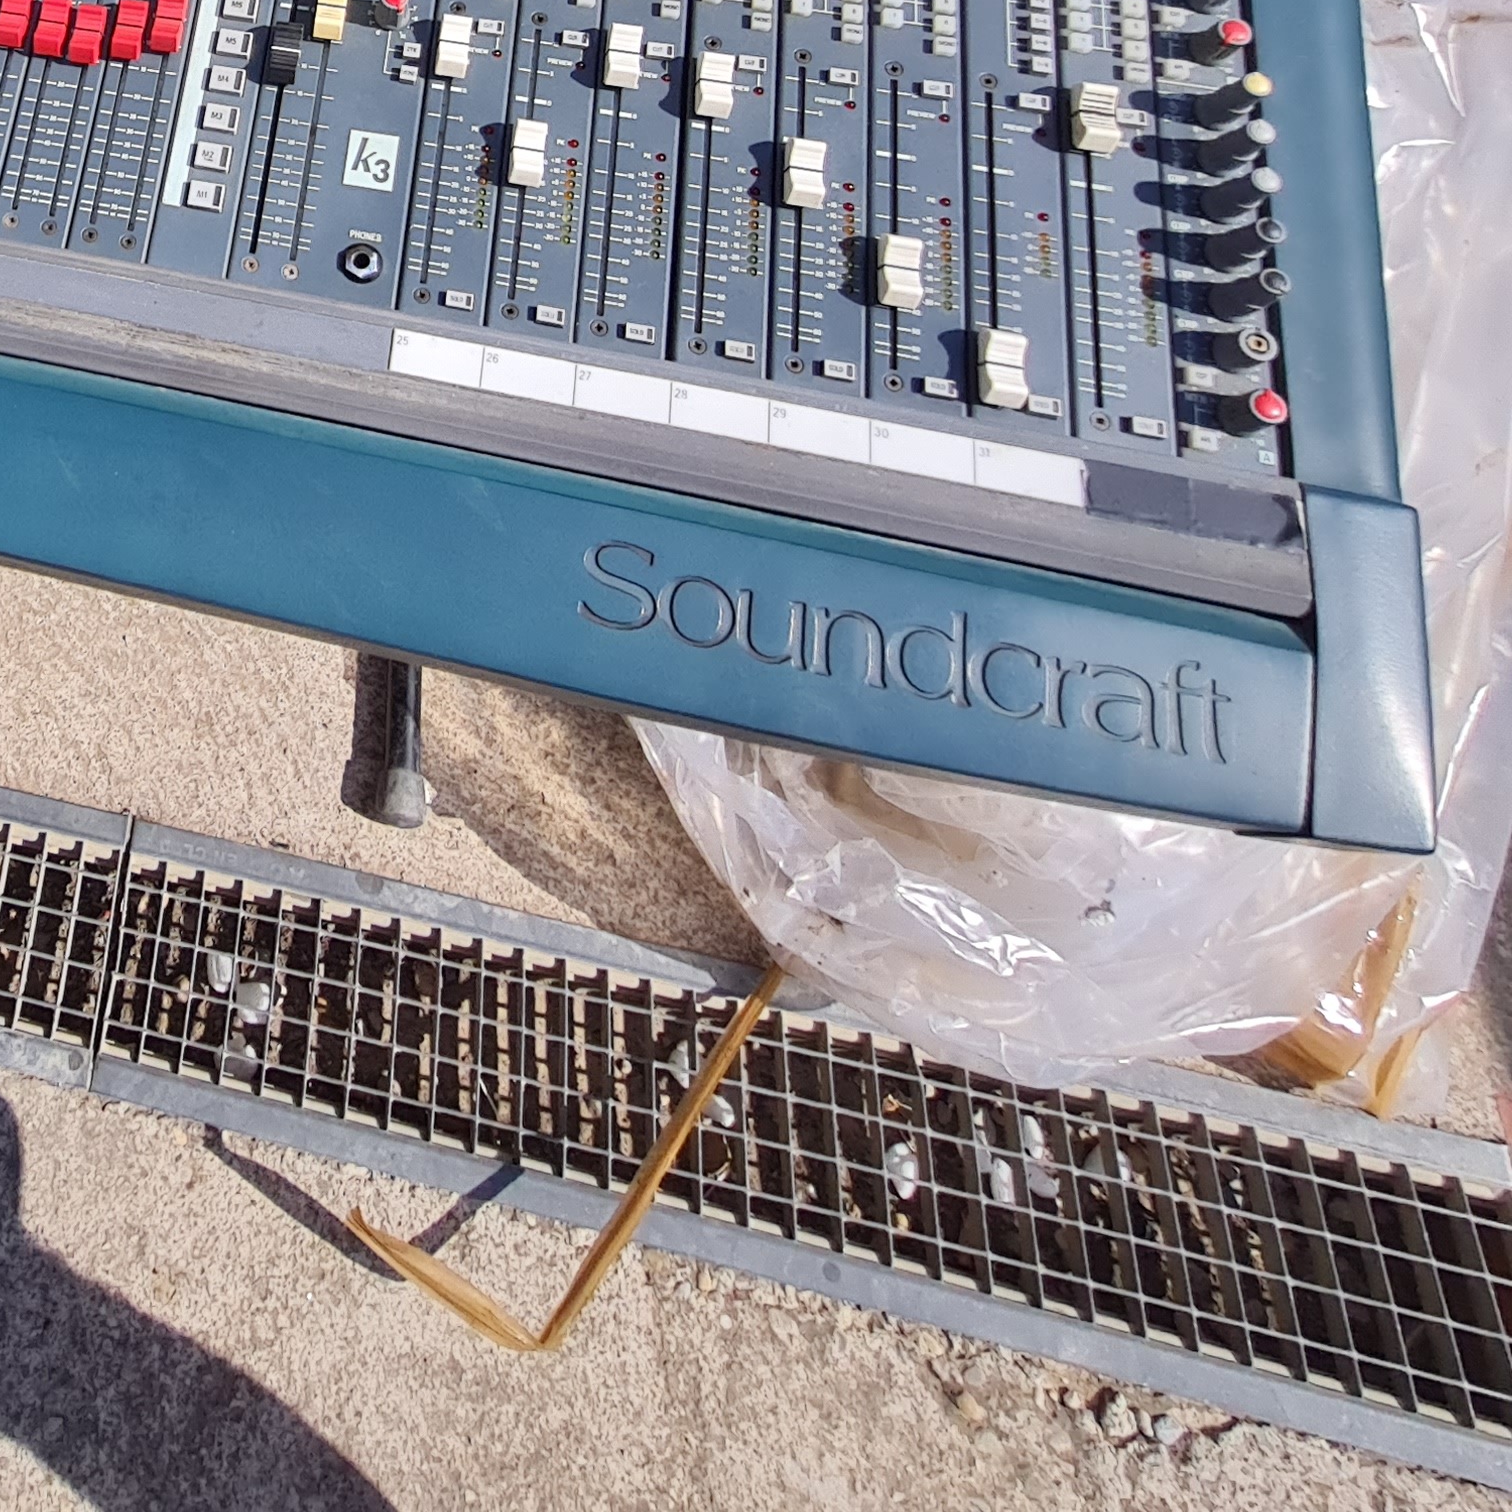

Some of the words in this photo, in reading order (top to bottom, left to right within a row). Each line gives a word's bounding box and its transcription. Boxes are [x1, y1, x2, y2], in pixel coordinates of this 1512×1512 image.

[211, 112, 223, 121] M3
[201, 150, 215, 159] M2
[349, 229, 382, 242] PHONES
[395, 334, 410, 347] 25
[486, 352, 499, 364] 26
[578, 370, 592, 381] 27
[674, 388, 688, 399] 28
[772, 407, 787, 419] 29
[874, 427, 890, 439] 30
[577, 538, 1232, 765] Soundcraft
